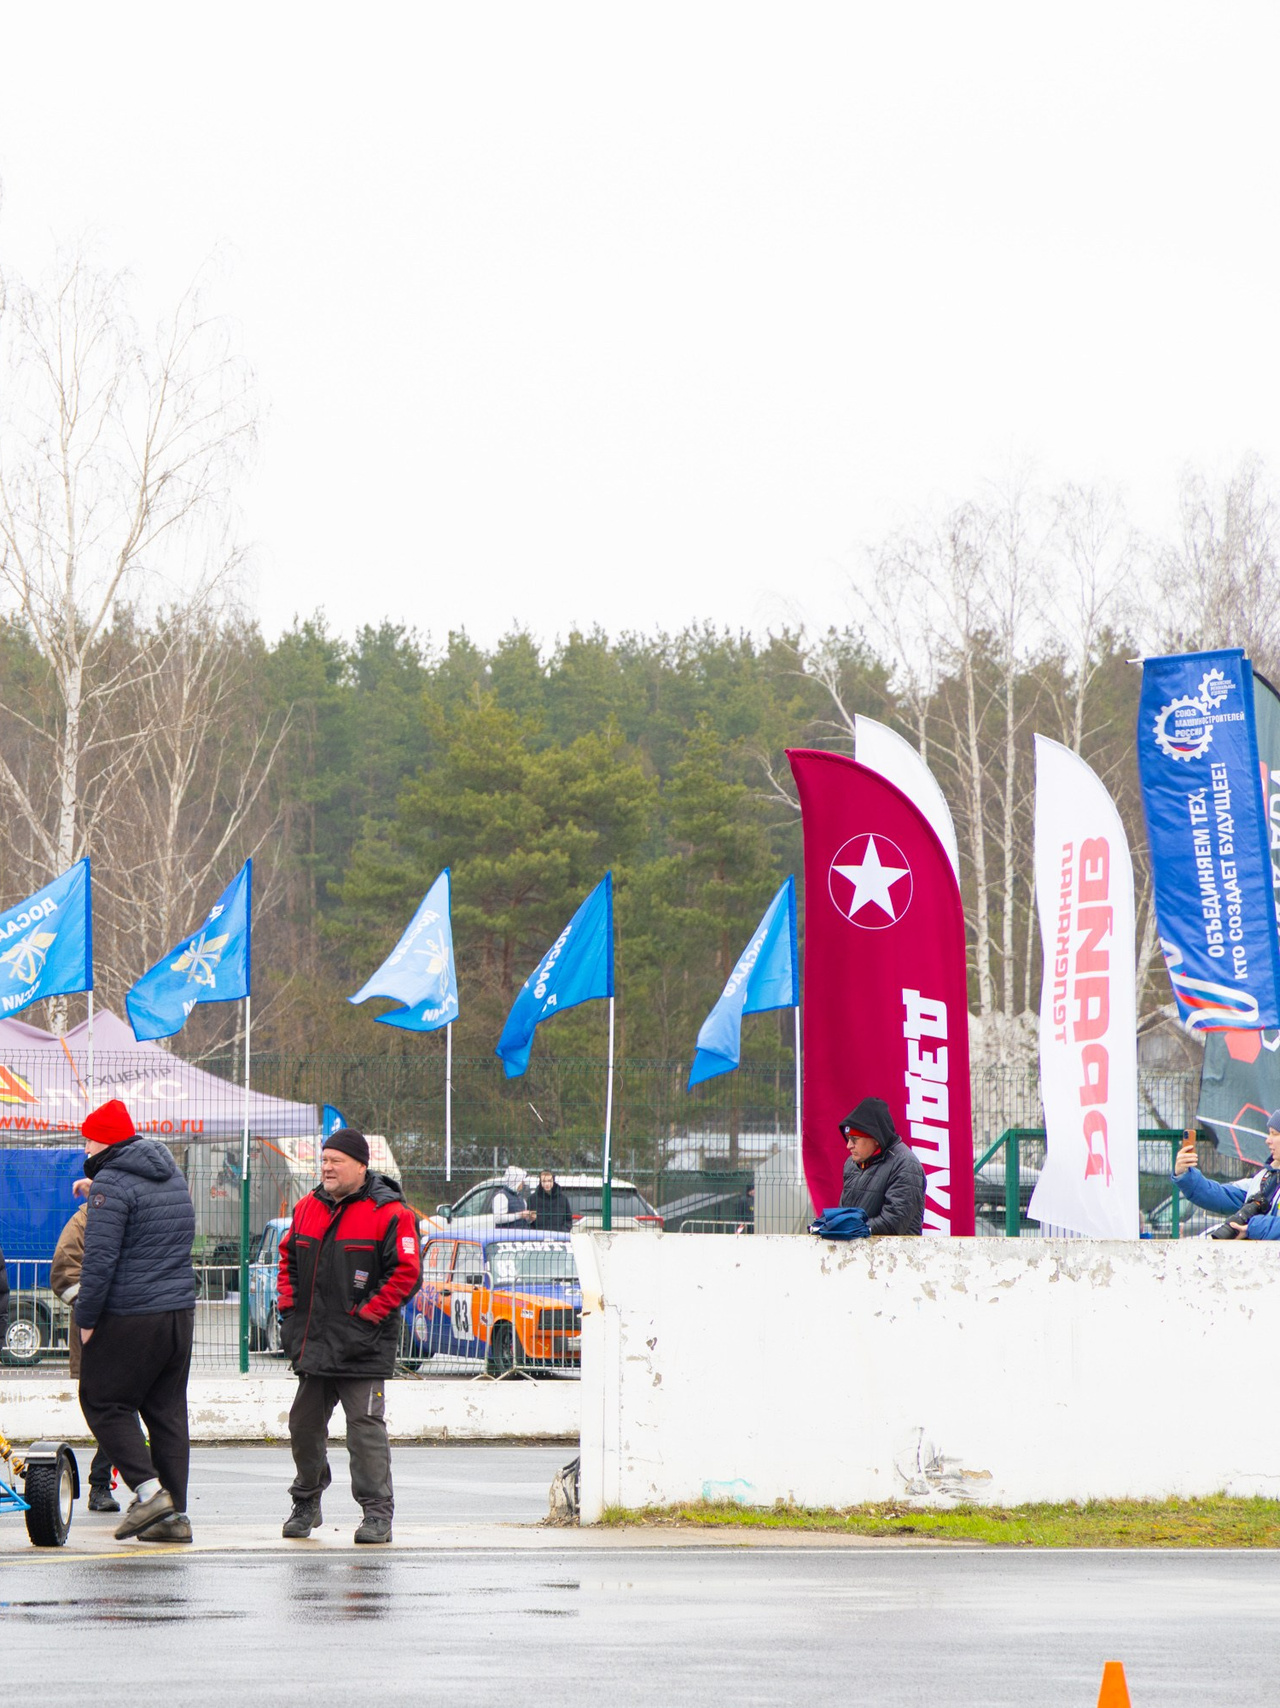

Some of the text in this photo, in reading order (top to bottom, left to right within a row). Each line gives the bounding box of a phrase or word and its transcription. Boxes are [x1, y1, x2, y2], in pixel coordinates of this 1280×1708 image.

[1175, 708, 1197, 718] СОЮЗ
[1175, 711, 1245, 728] МАШИНОСТРОИТЕЛЕЙ
[1175, 727, 1203, 738] РОССИИ
[1188, 787, 1225, 958] ОБЪЕДИНЯЕМ ТЕХ,
[1211, 762, 1248, 980] КТО СОЗДАЕТ БУДУЩЕЕ!
[454, 1299, 469, 1333] 83
